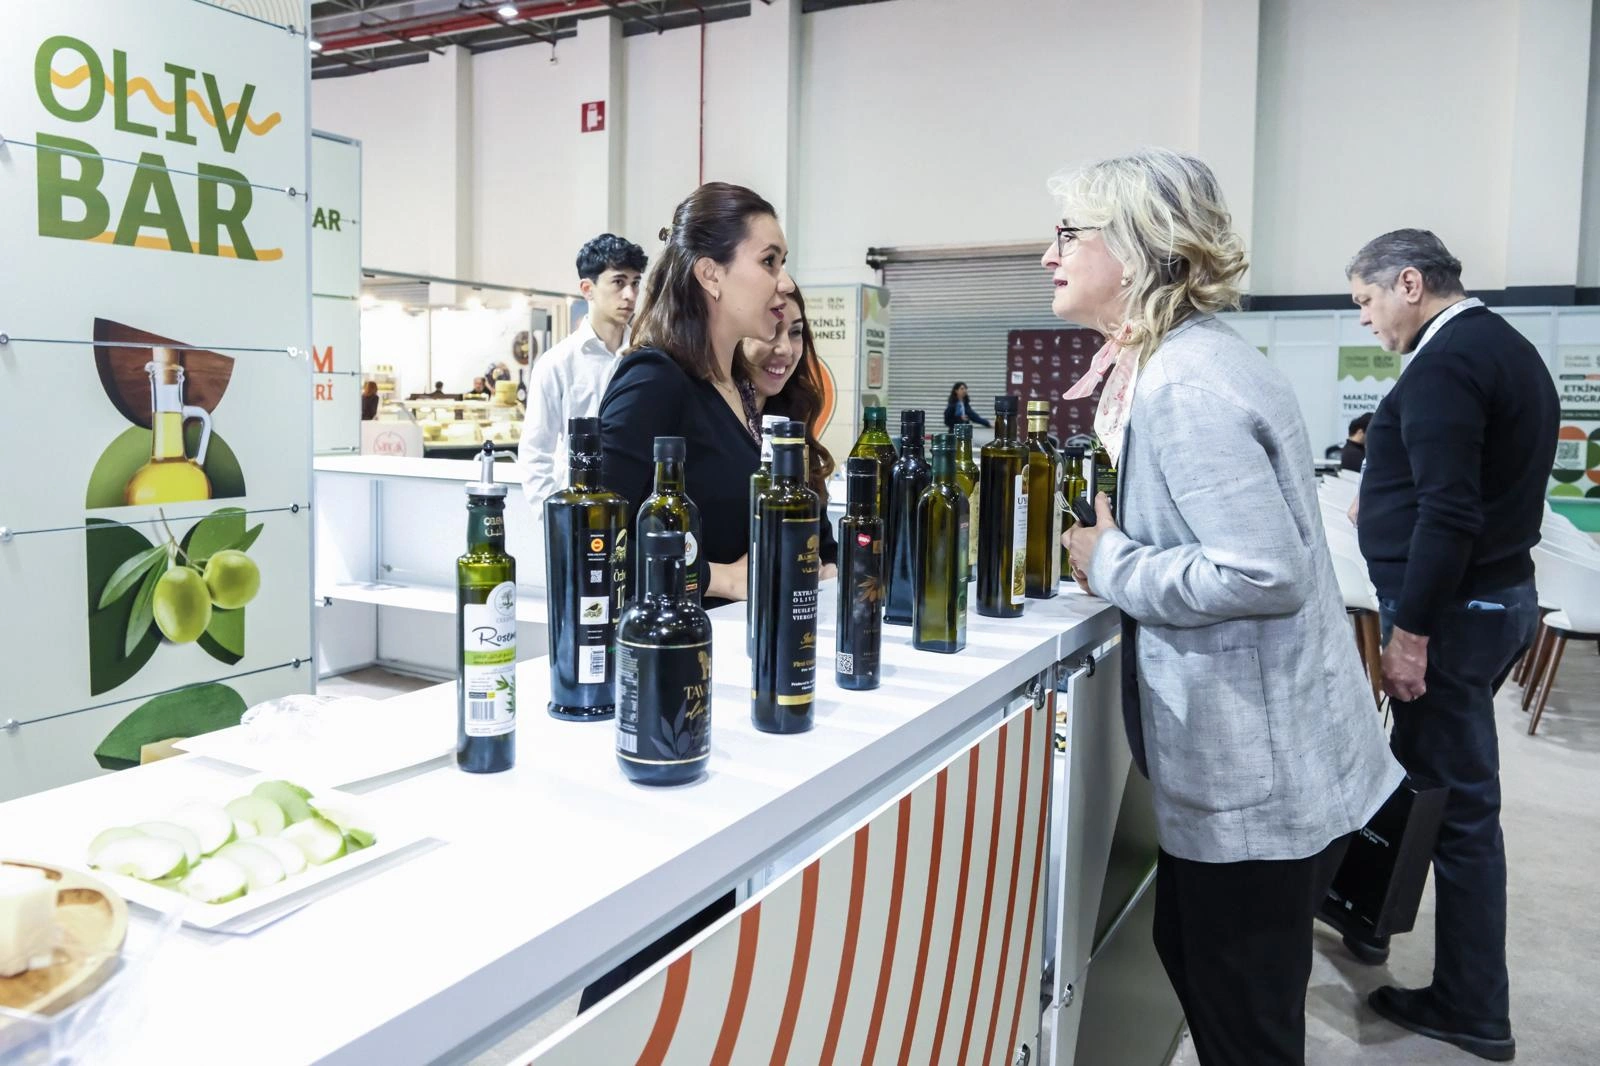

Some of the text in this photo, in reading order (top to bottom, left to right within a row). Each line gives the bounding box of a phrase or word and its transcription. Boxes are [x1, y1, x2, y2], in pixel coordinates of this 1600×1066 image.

[34, 35, 256, 154] OLIV
[36, 131, 259, 261] BAR
[1343, 393, 1378, 401] MAKİNE
